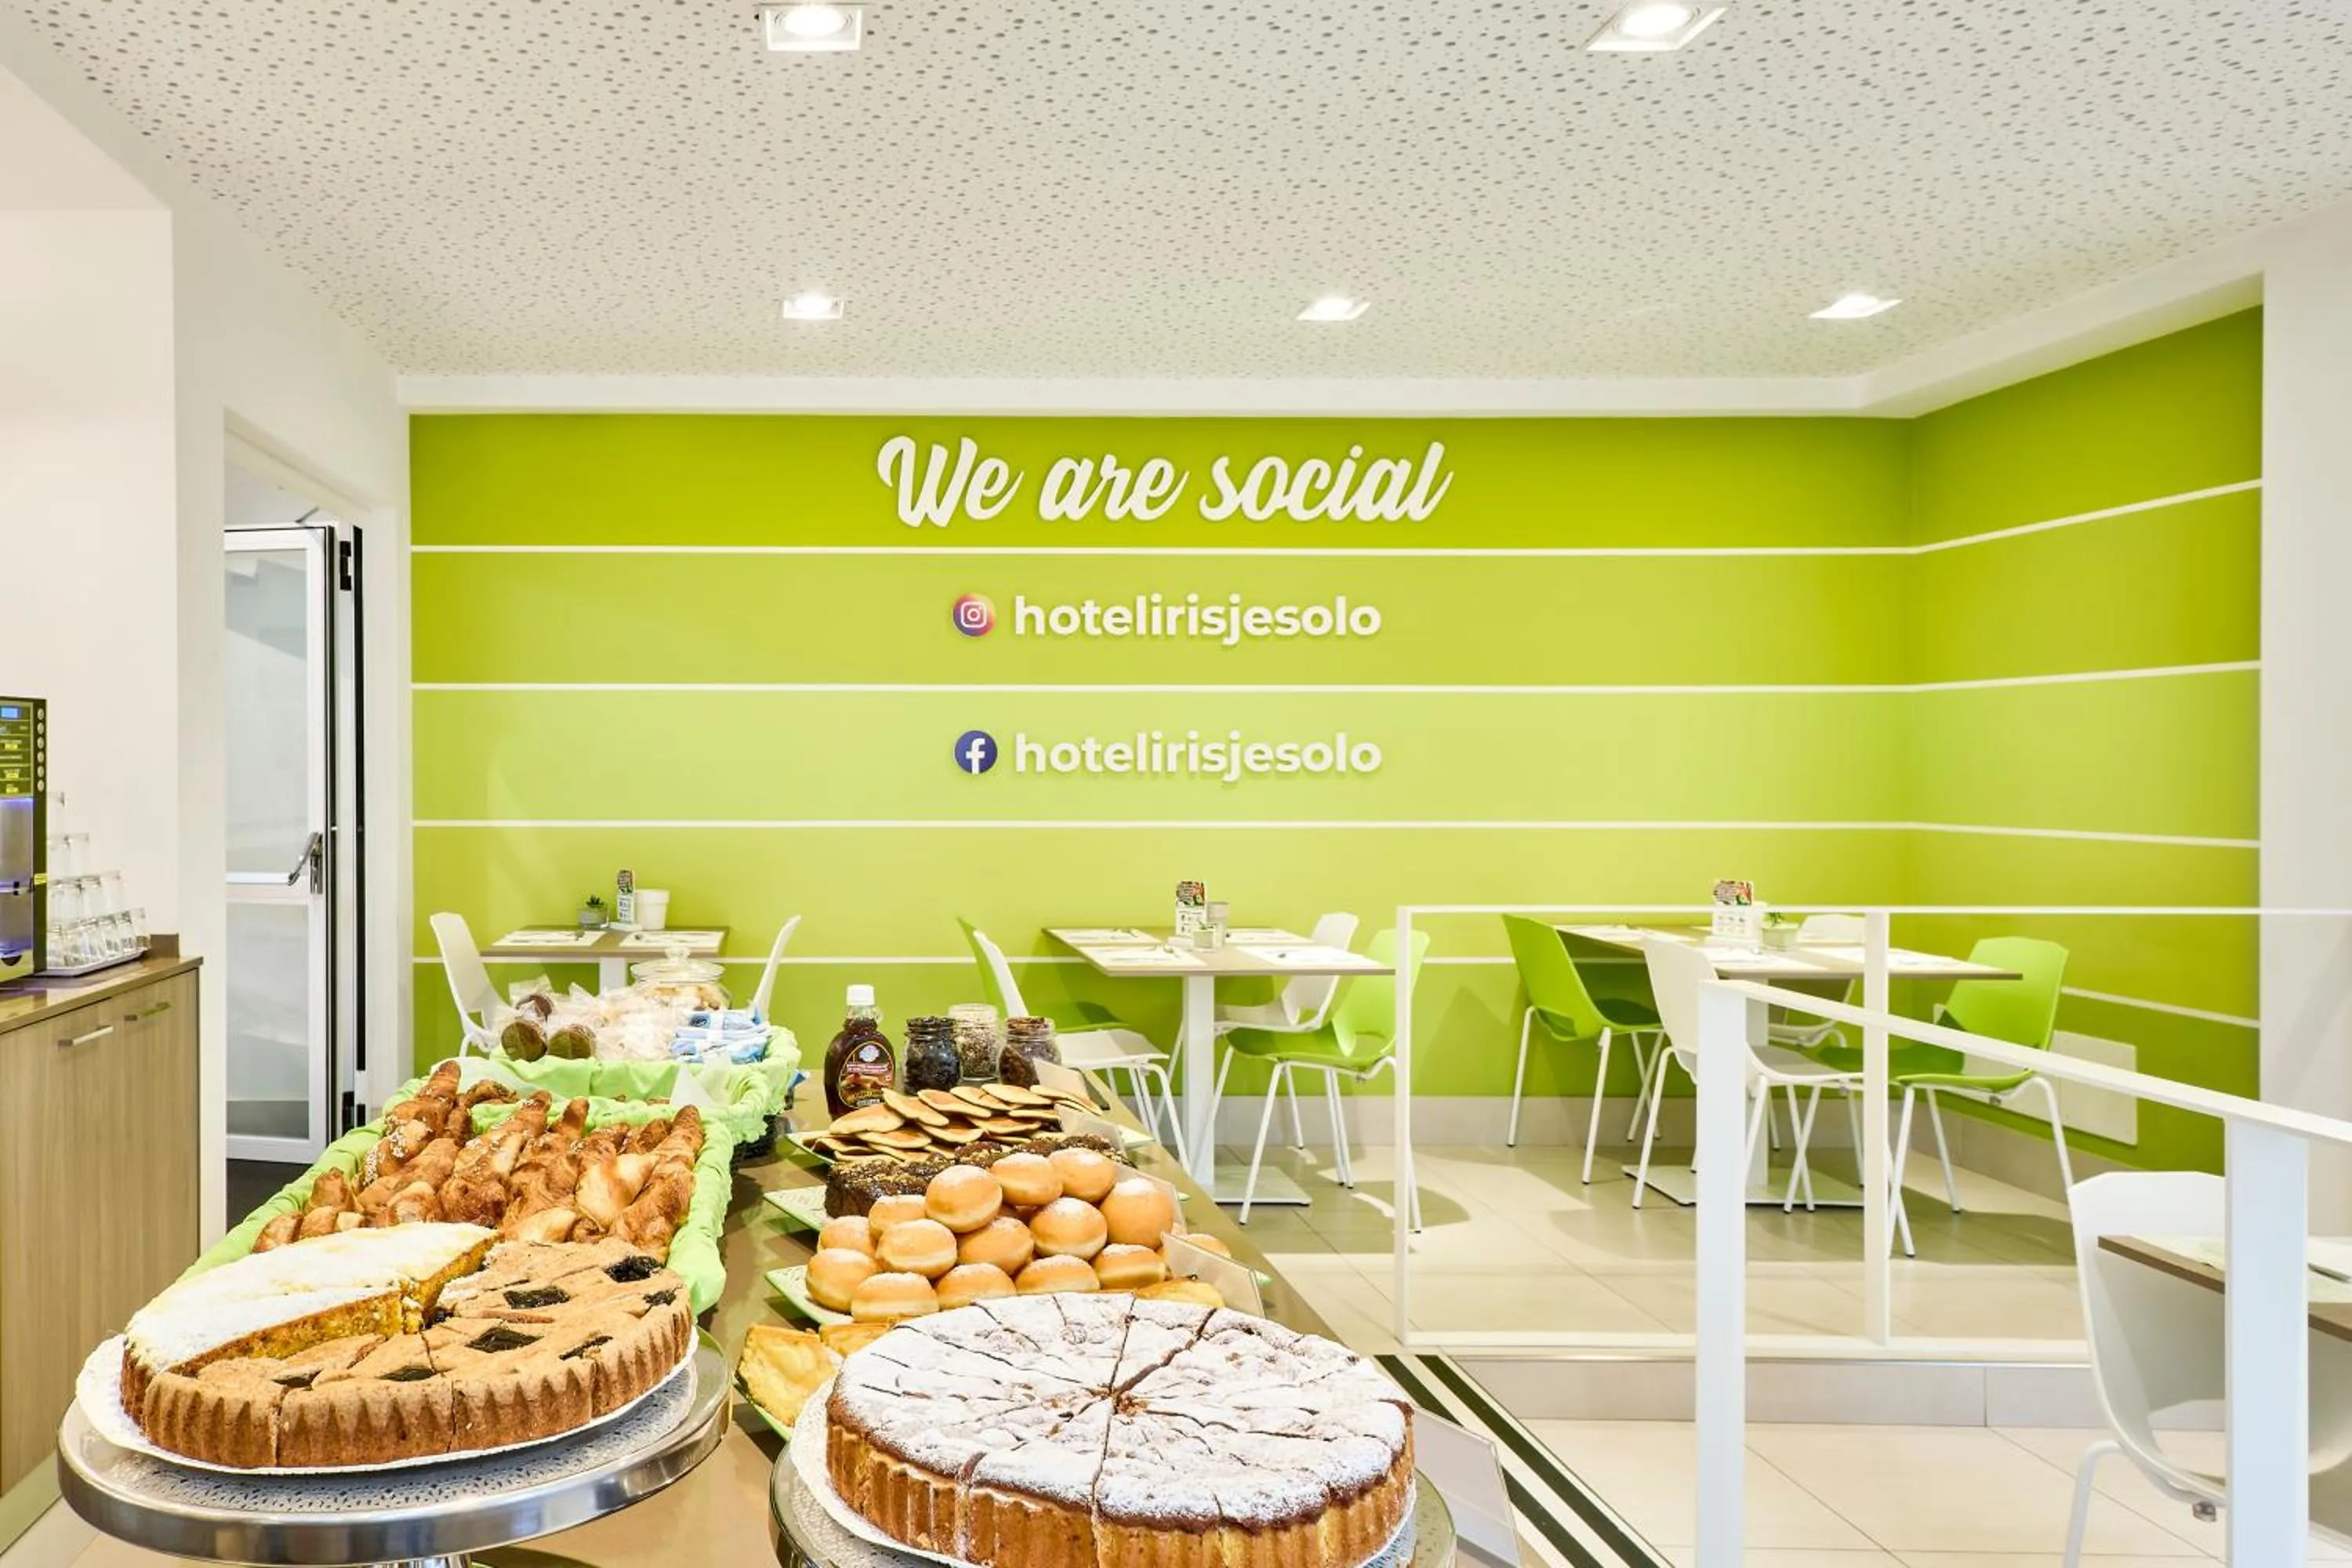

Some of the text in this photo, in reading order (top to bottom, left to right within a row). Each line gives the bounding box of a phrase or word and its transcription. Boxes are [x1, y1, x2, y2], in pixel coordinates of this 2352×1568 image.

[877, 434, 1454, 528] We are social
[1014, 592, 1382, 645] hotelirisjesolo
[1014, 729, 1382, 782] hotelirisjesolo
